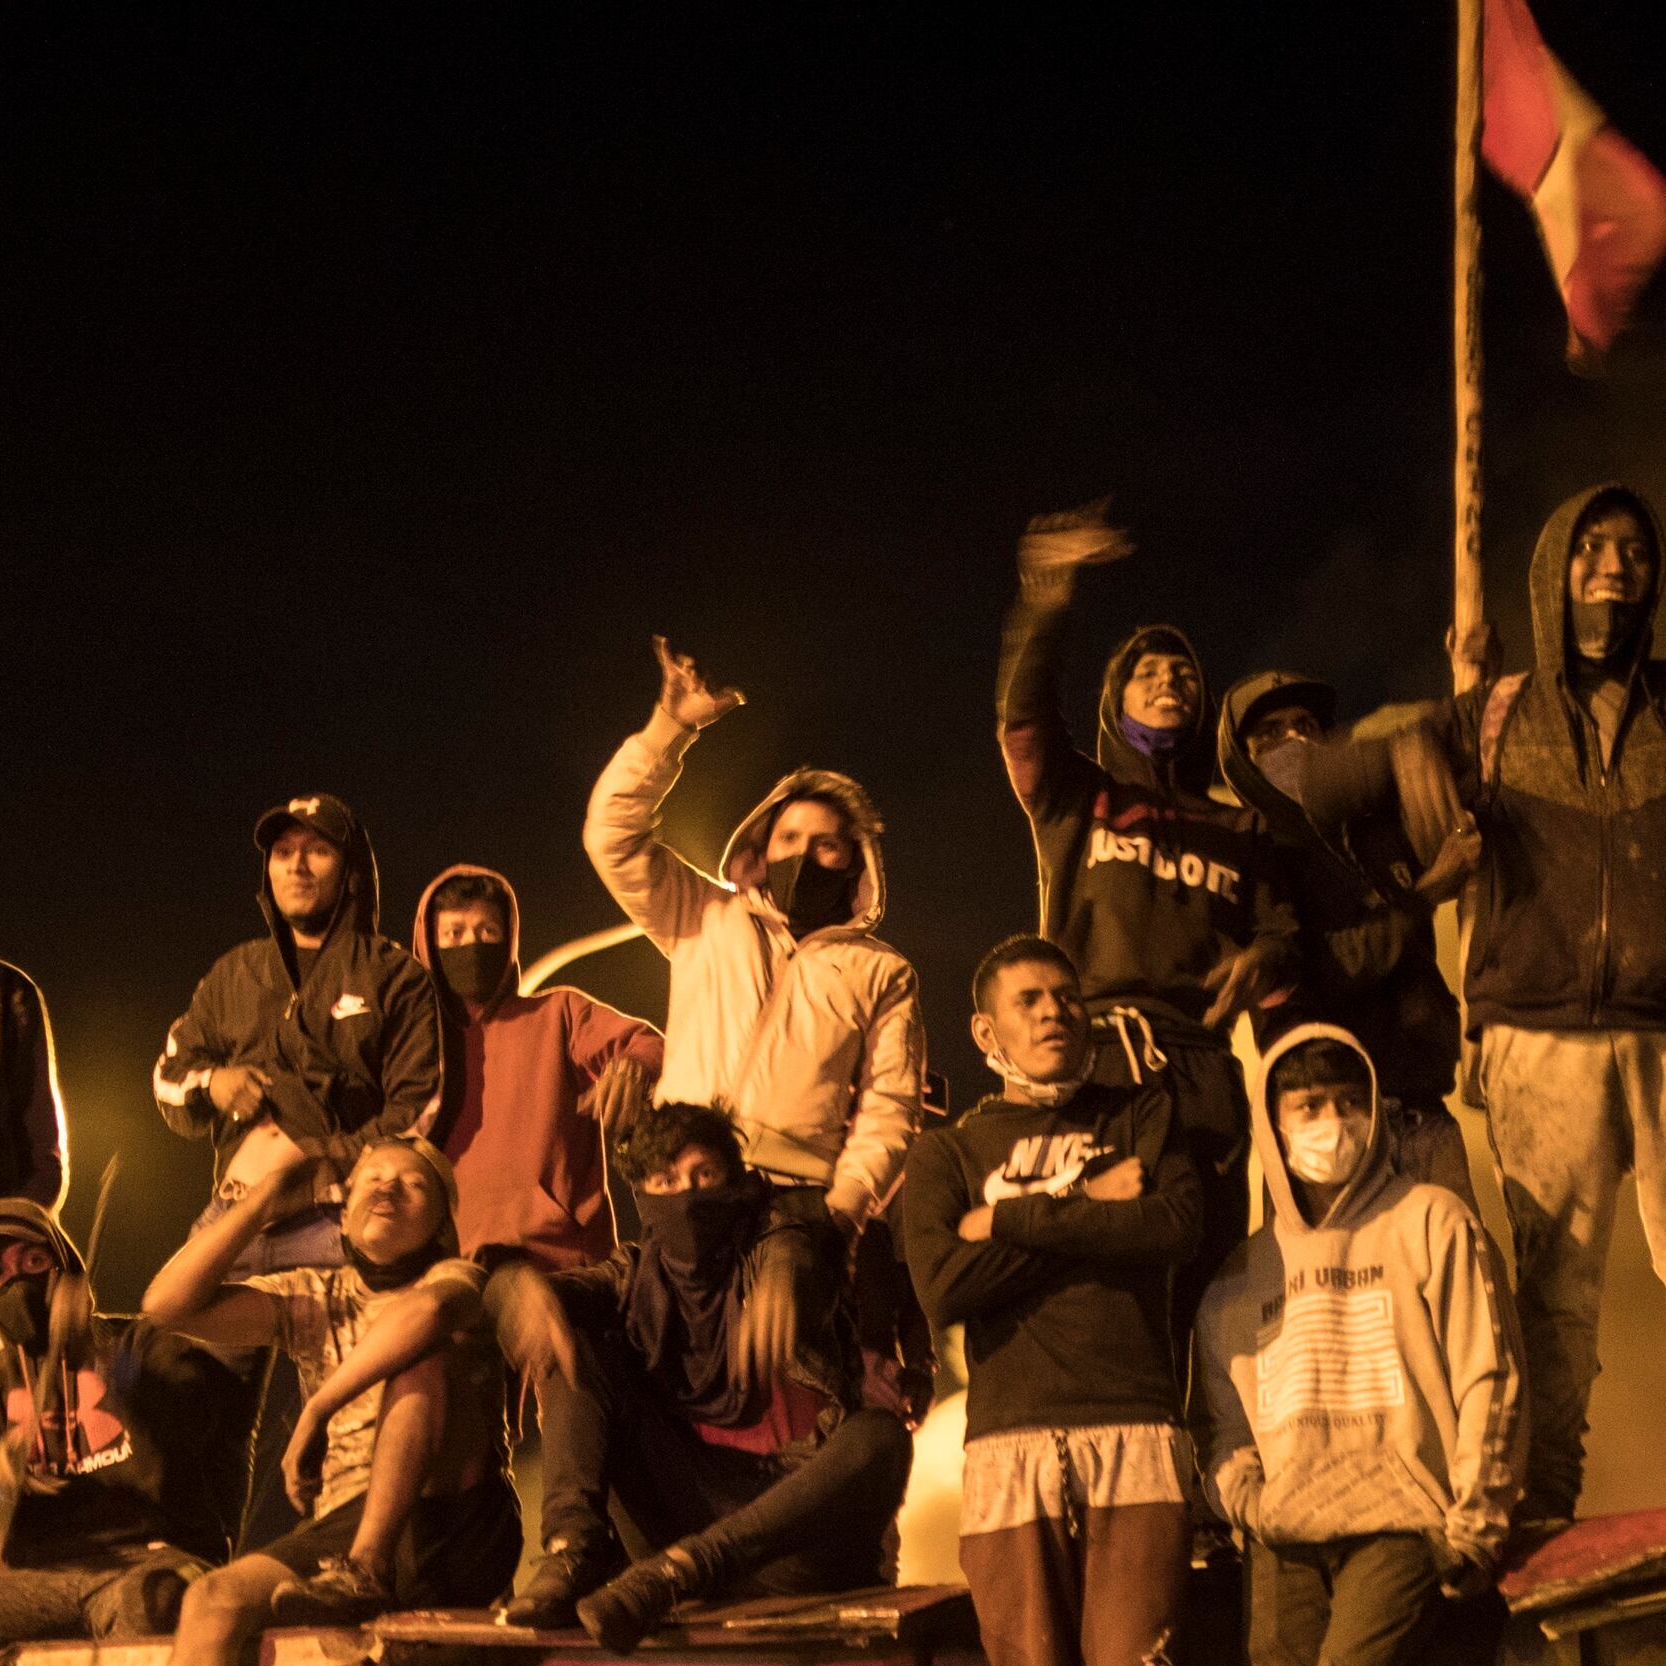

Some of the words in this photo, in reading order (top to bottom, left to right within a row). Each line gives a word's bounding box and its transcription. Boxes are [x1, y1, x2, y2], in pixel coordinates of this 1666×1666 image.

[1087, 828, 1152, 870] JUST
[1004, 1131, 1101, 1178] NIKE
[1314, 1265, 1384, 1291] URBAN
